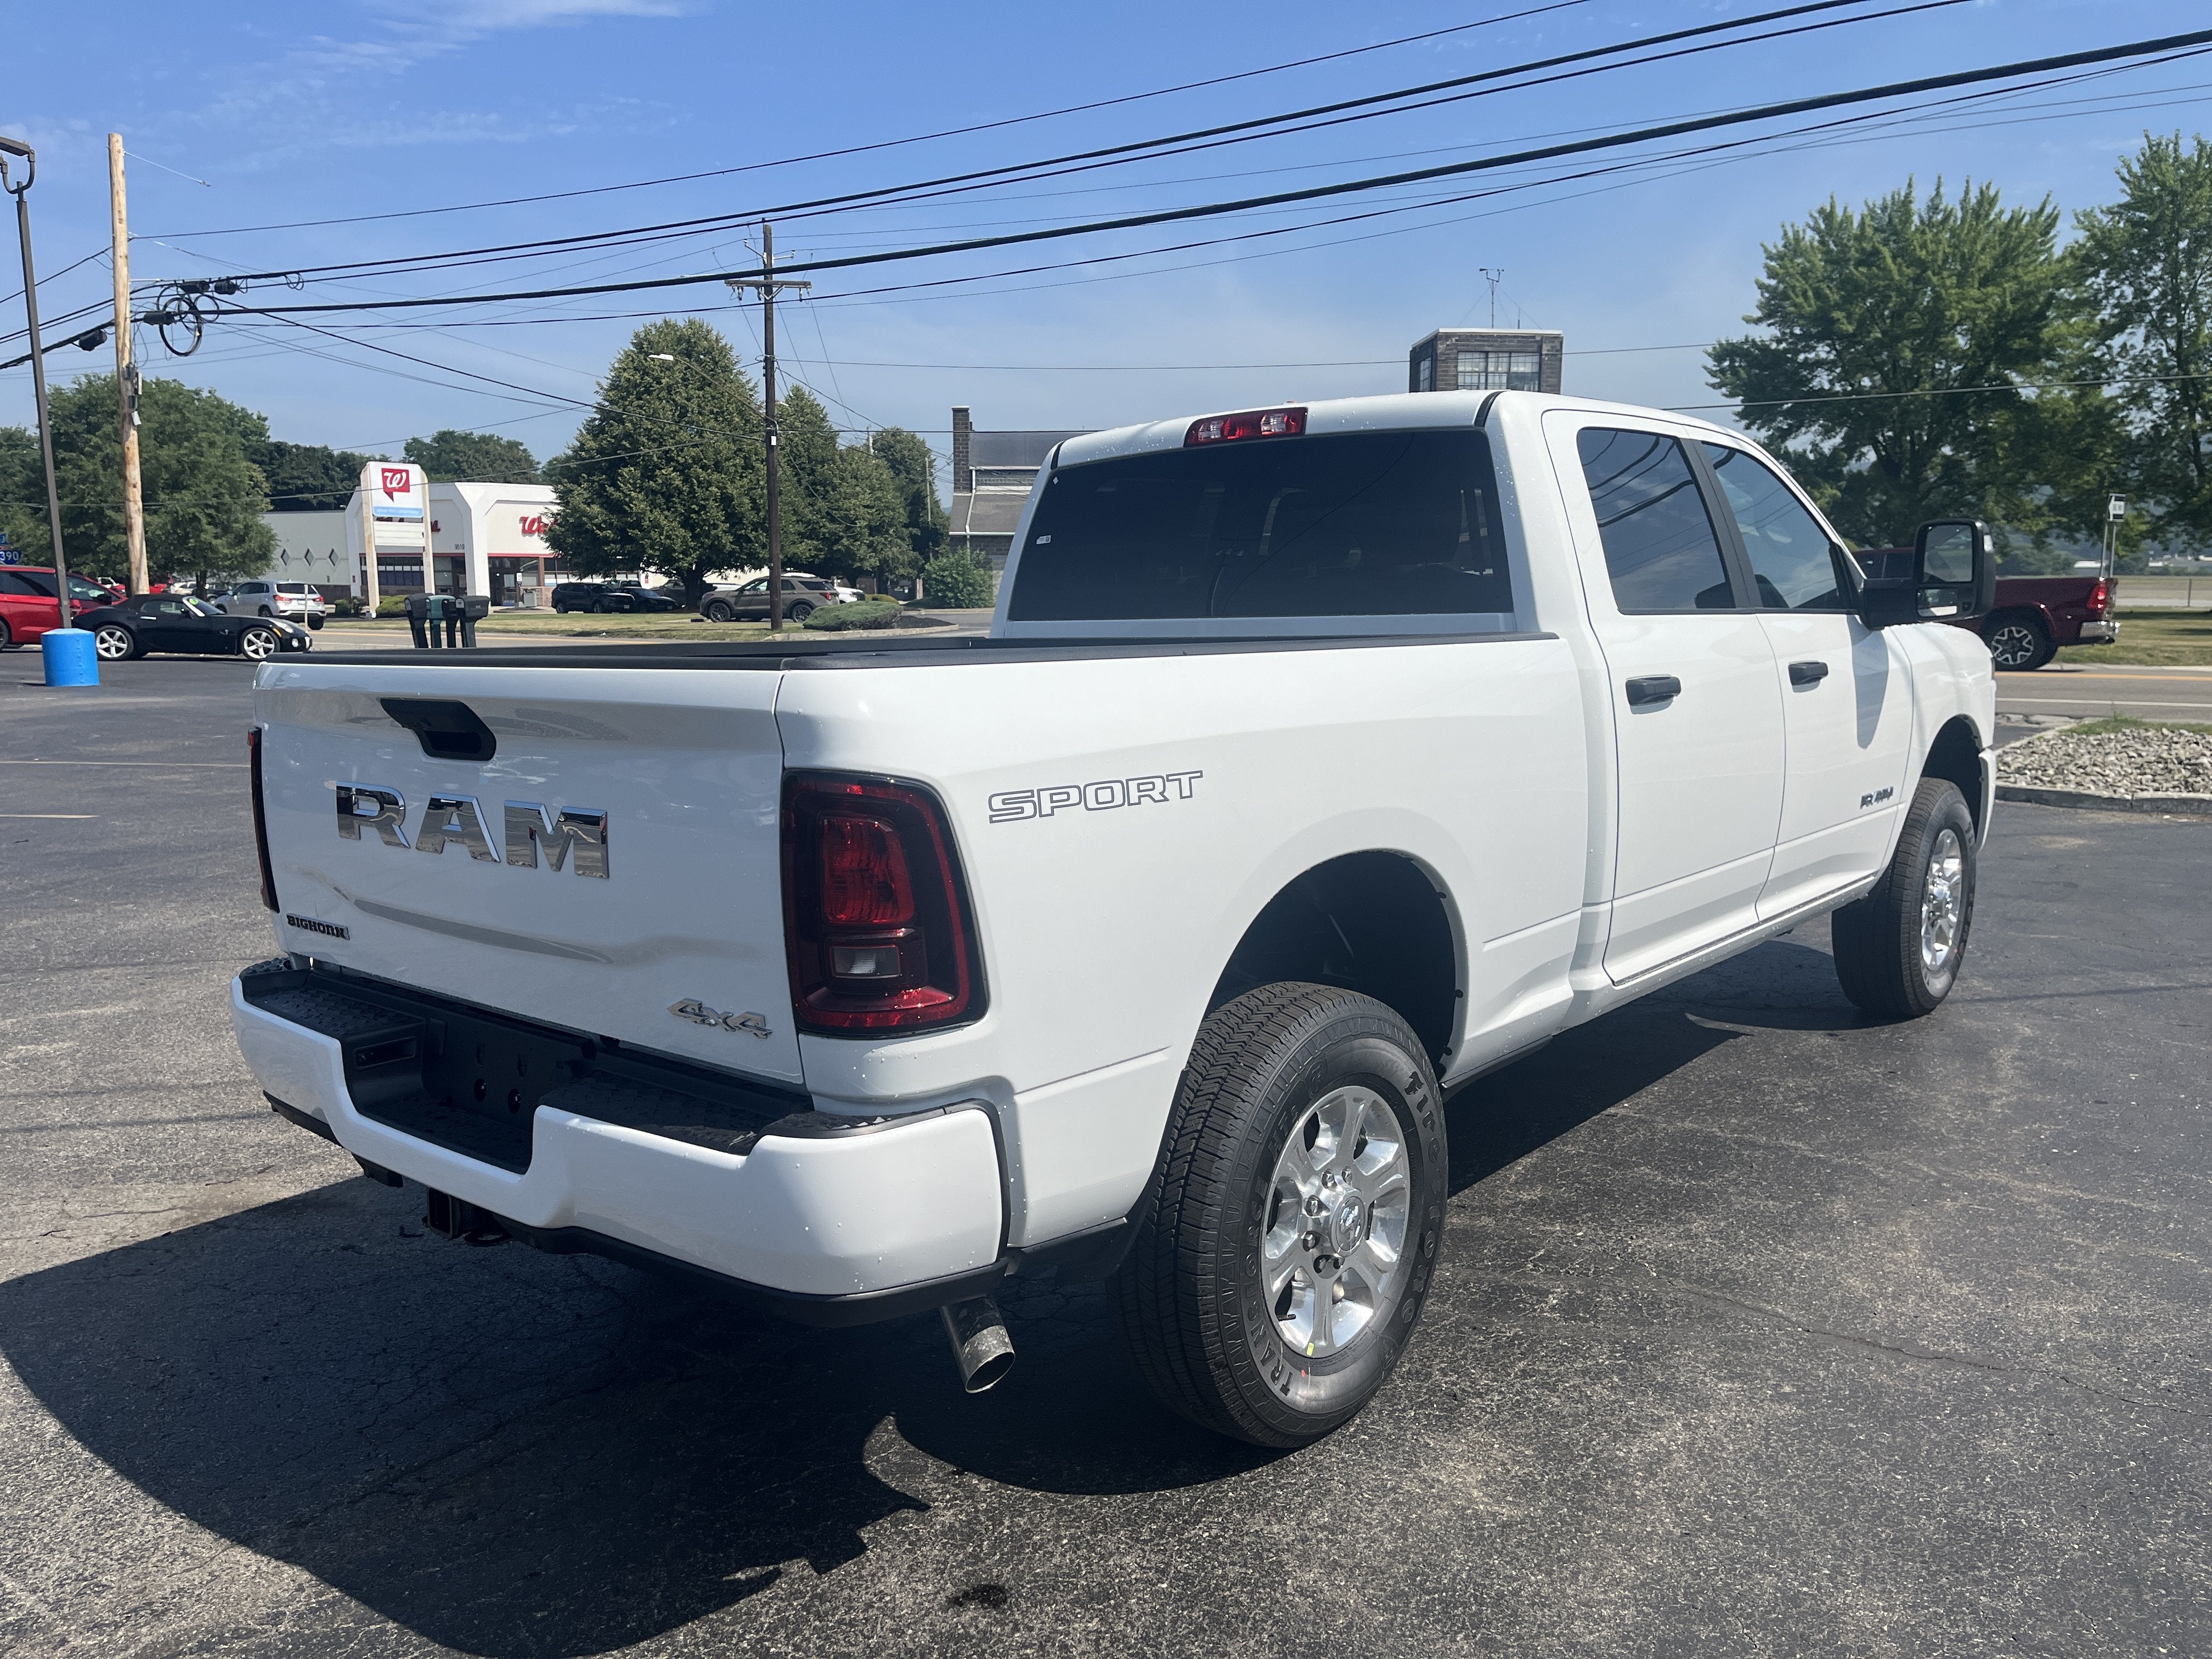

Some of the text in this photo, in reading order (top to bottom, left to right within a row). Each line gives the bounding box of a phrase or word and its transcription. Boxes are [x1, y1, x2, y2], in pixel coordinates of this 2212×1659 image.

[383, 471, 407, 488] W
[0, 551, 19, 561] 390
[988, 770, 1203, 823] SPORT
[1860, 786, 1893, 810] RAM
[336, 781, 610, 879] RAM
[286, 914, 348, 940] BIGHORN
[1247, 1176, 1294, 1396] TRANSFORCE
